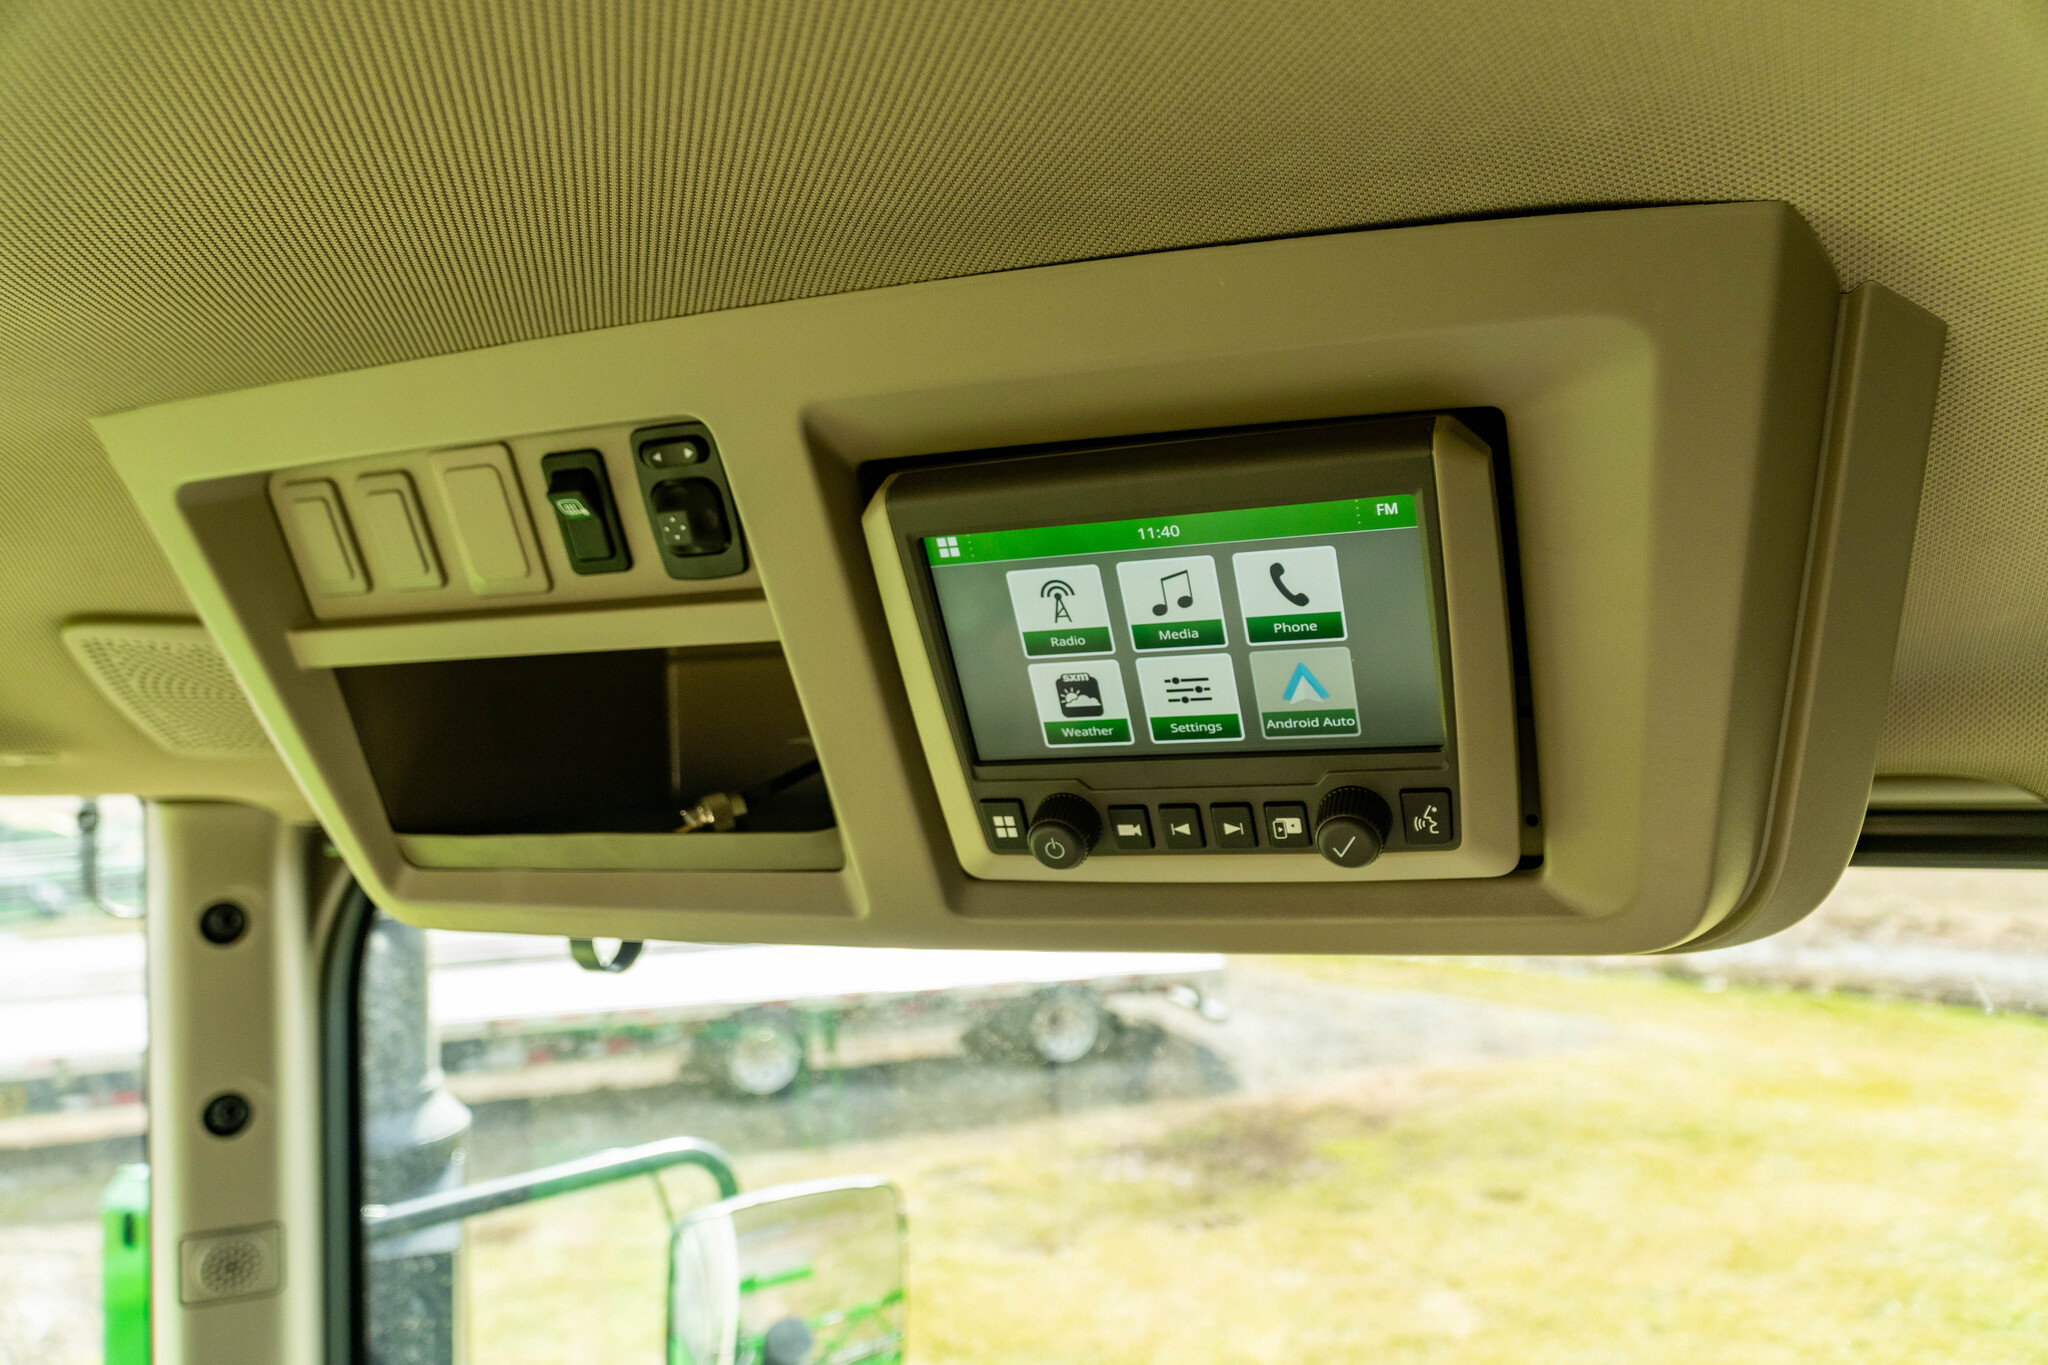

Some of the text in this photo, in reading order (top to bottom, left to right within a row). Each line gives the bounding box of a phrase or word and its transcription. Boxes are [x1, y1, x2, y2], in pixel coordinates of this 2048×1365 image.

[1376, 502, 1398, 516] FM
[1138, 524, 1179, 540] 11:40
[1158, 626, 1200, 641] Media
[1273, 619, 1318, 634] Phone
[1050, 634, 1086, 647] Radio
[1170, 719, 1223, 735] Settings
[1266, 715, 1356, 730] Android Auto
[1061, 726, 1114, 738] Weather
